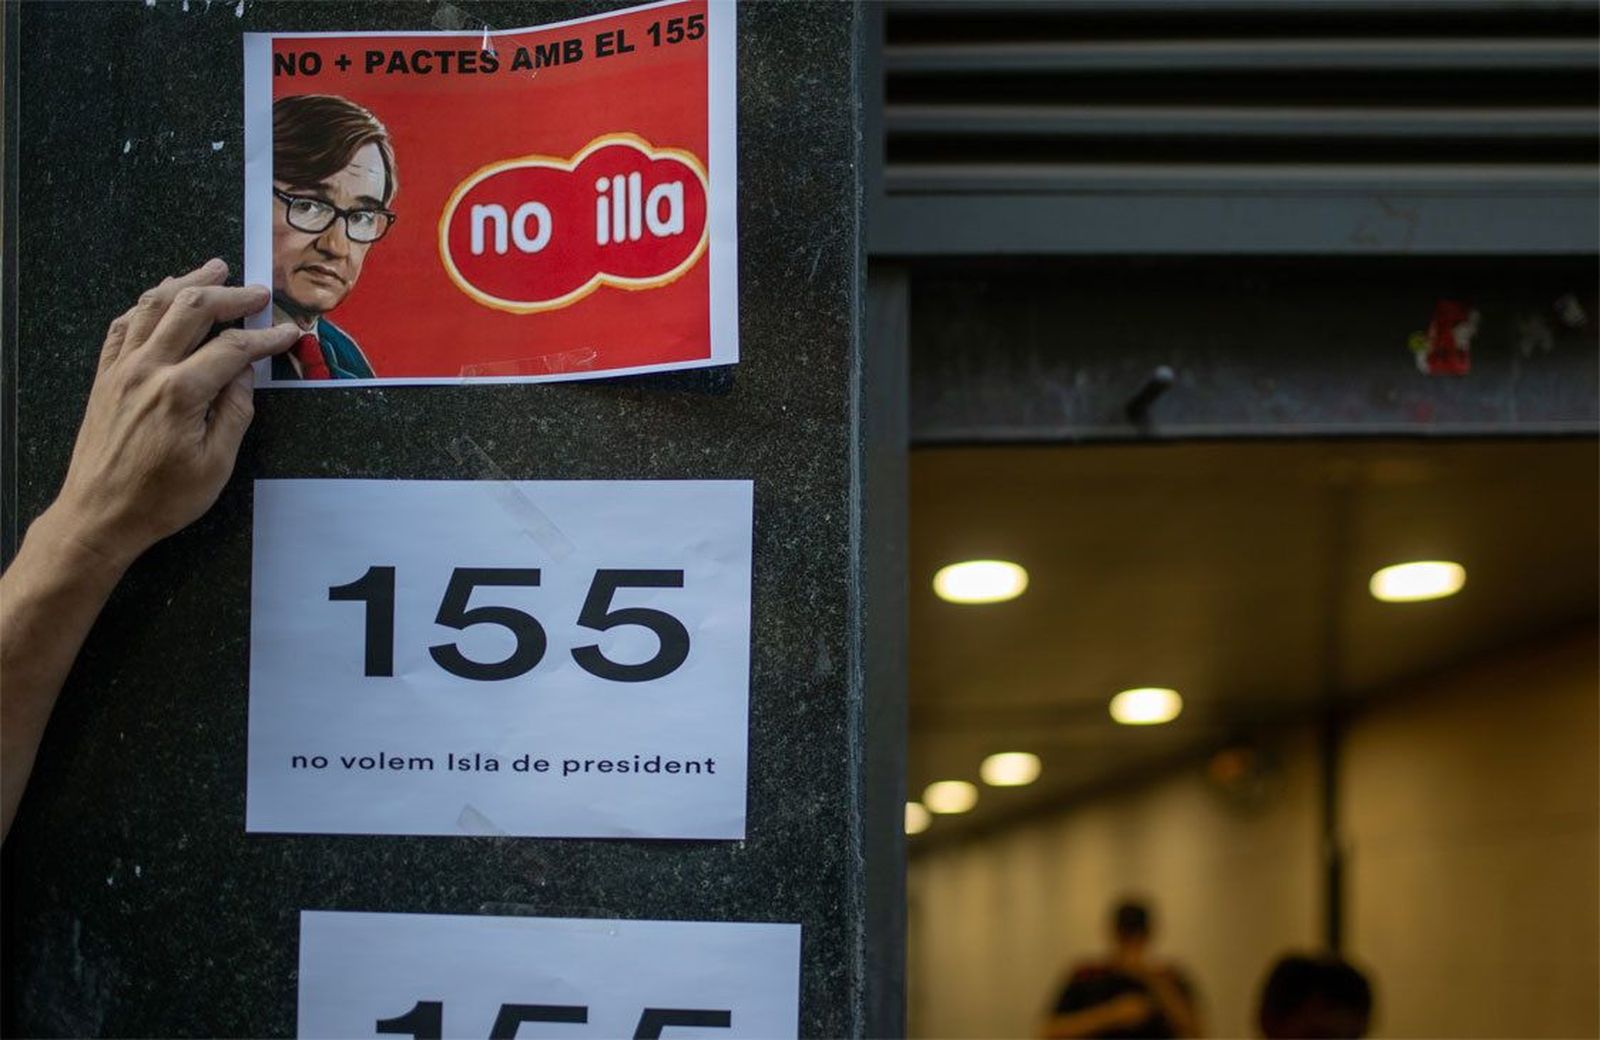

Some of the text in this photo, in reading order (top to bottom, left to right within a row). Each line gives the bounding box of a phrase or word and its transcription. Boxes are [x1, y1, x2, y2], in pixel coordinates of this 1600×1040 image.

[274, 14, 706, 77] NO + PACTES AMB EL 155
[470, 171, 684, 255] no illa
[328, 566, 690, 682] 155
[292, 754, 328, 769] no
[340, 752, 434, 770] volem
[512, 754, 550, 772] de
[563, 755, 716, 777] president
